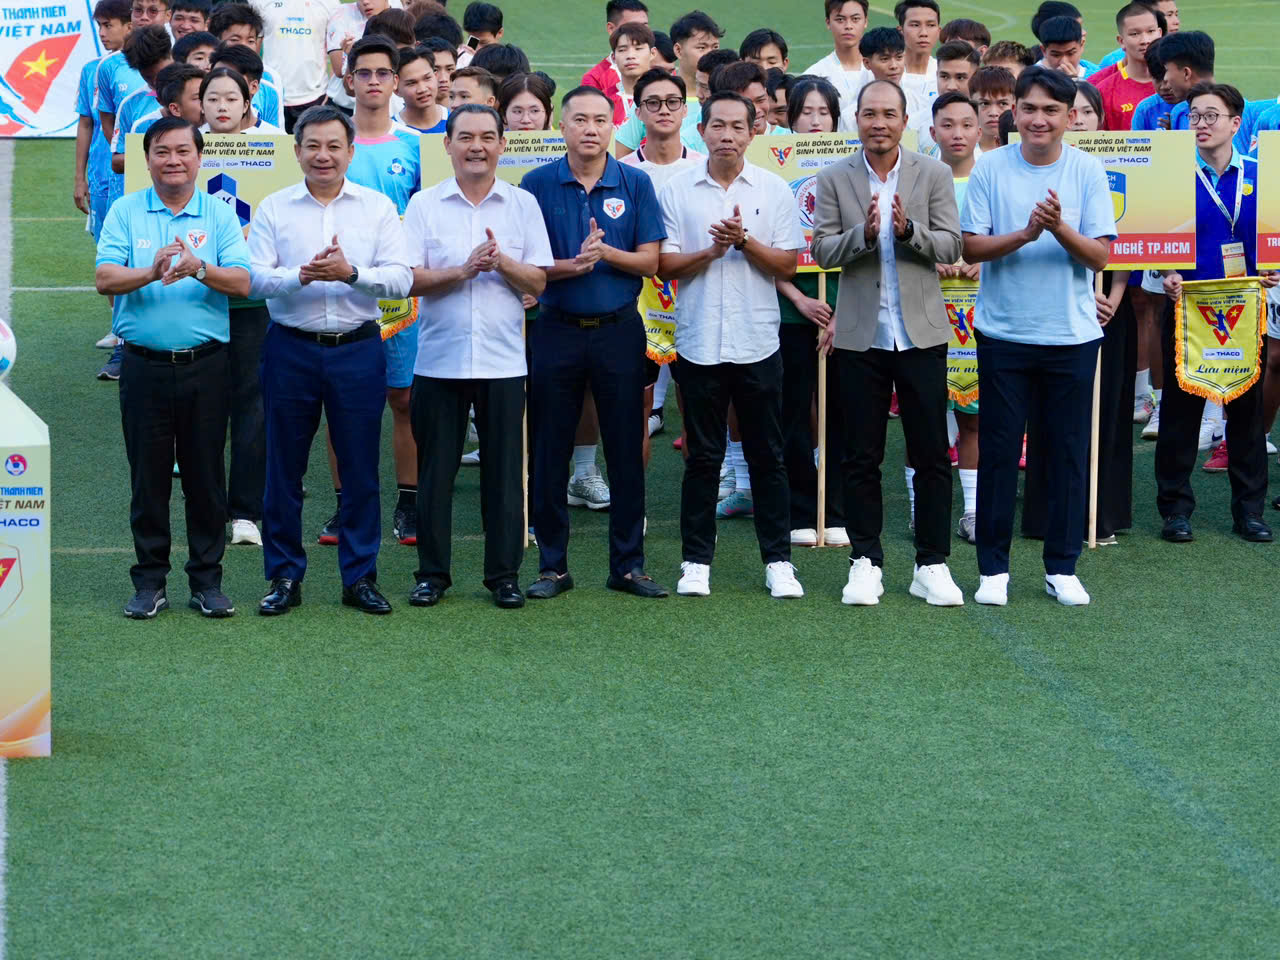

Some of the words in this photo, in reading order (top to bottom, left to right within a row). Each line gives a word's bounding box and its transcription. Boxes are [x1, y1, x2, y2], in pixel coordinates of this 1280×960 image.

[40, 20, 82, 36] NAM
[279, 27, 312, 35] THACO
[1114, 240, 1144, 256] NGHỆ
[1147, 242, 1190, 254] TP.HCM
[14, 500, 45, 510] NAM
